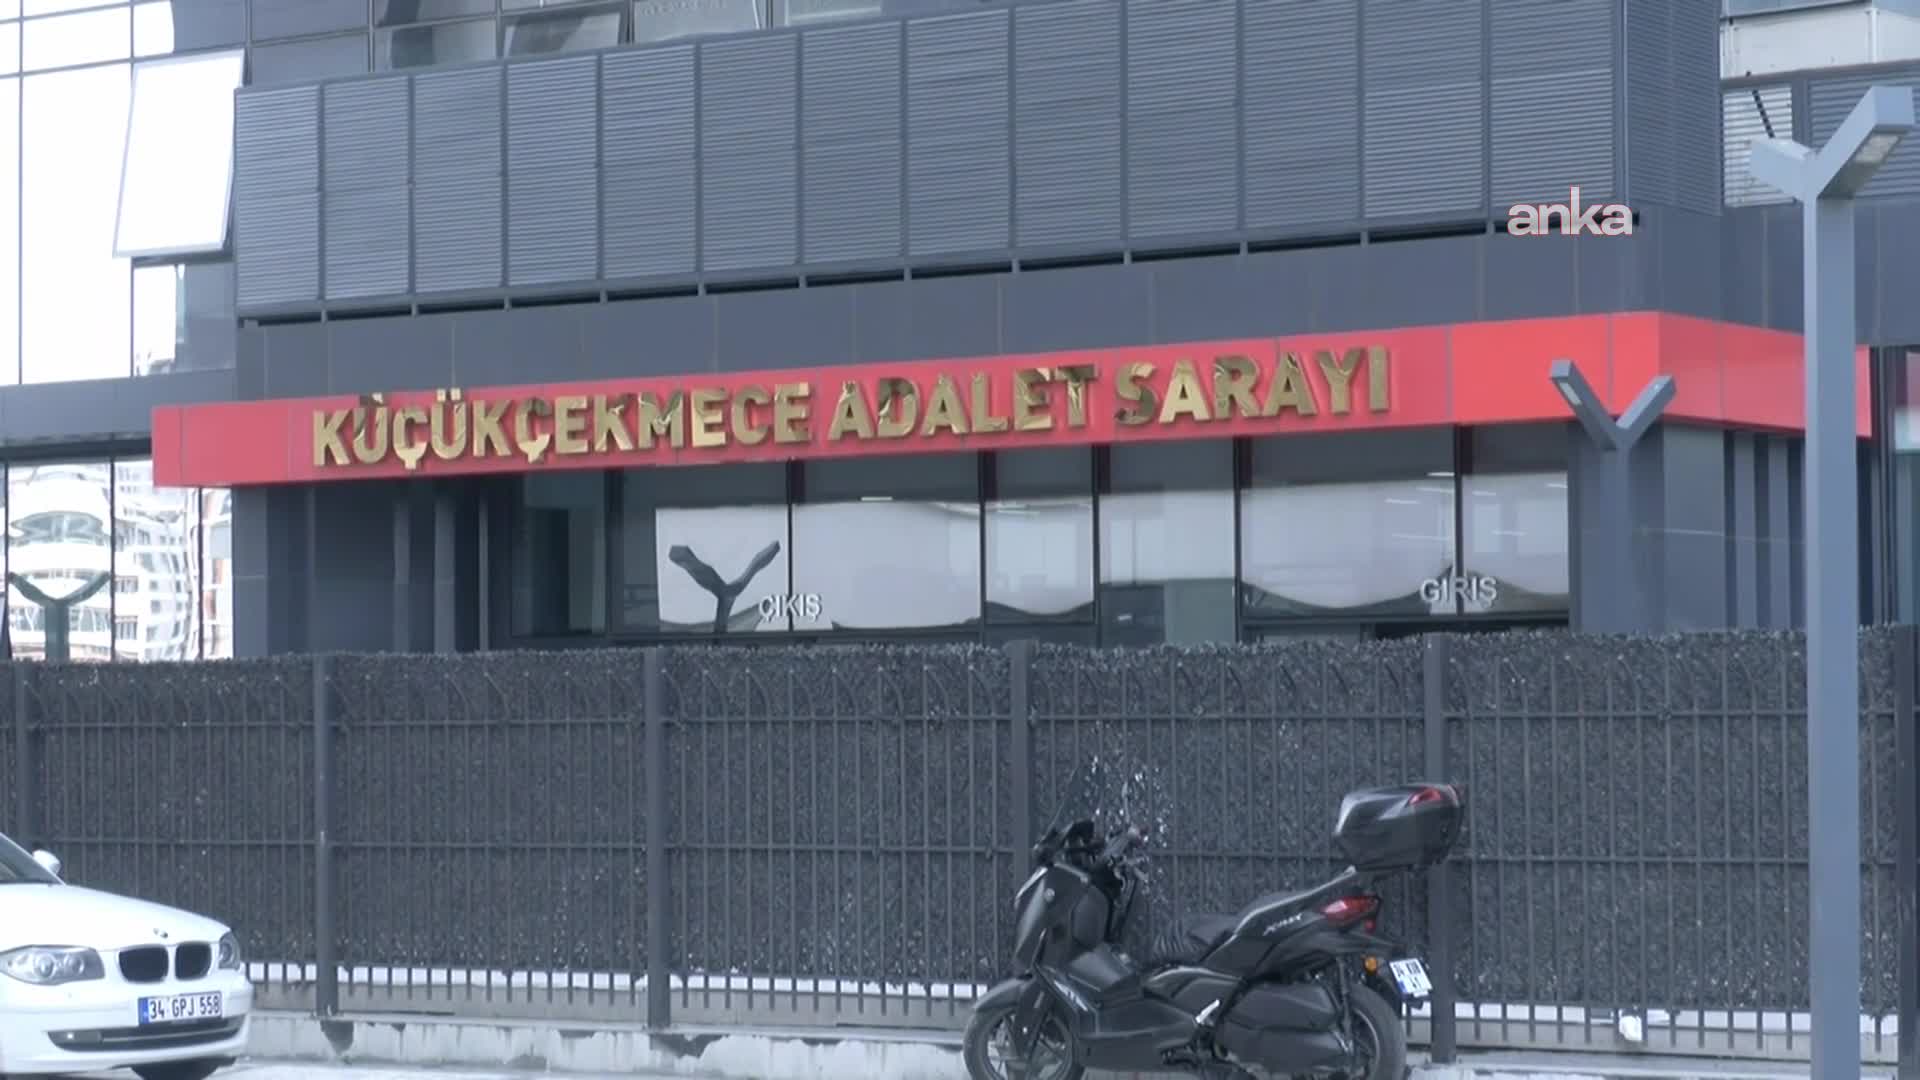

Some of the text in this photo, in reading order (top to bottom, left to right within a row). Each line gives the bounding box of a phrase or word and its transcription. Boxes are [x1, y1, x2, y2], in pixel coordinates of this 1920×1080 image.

[312, 344, 1392, 470] KÜÇÜKÇEKMECE ADALET SARAYI
[759, 593, 822, 623] ÇIKIŞ
[149, 995, 220, 1019] 34 GPJ 558
